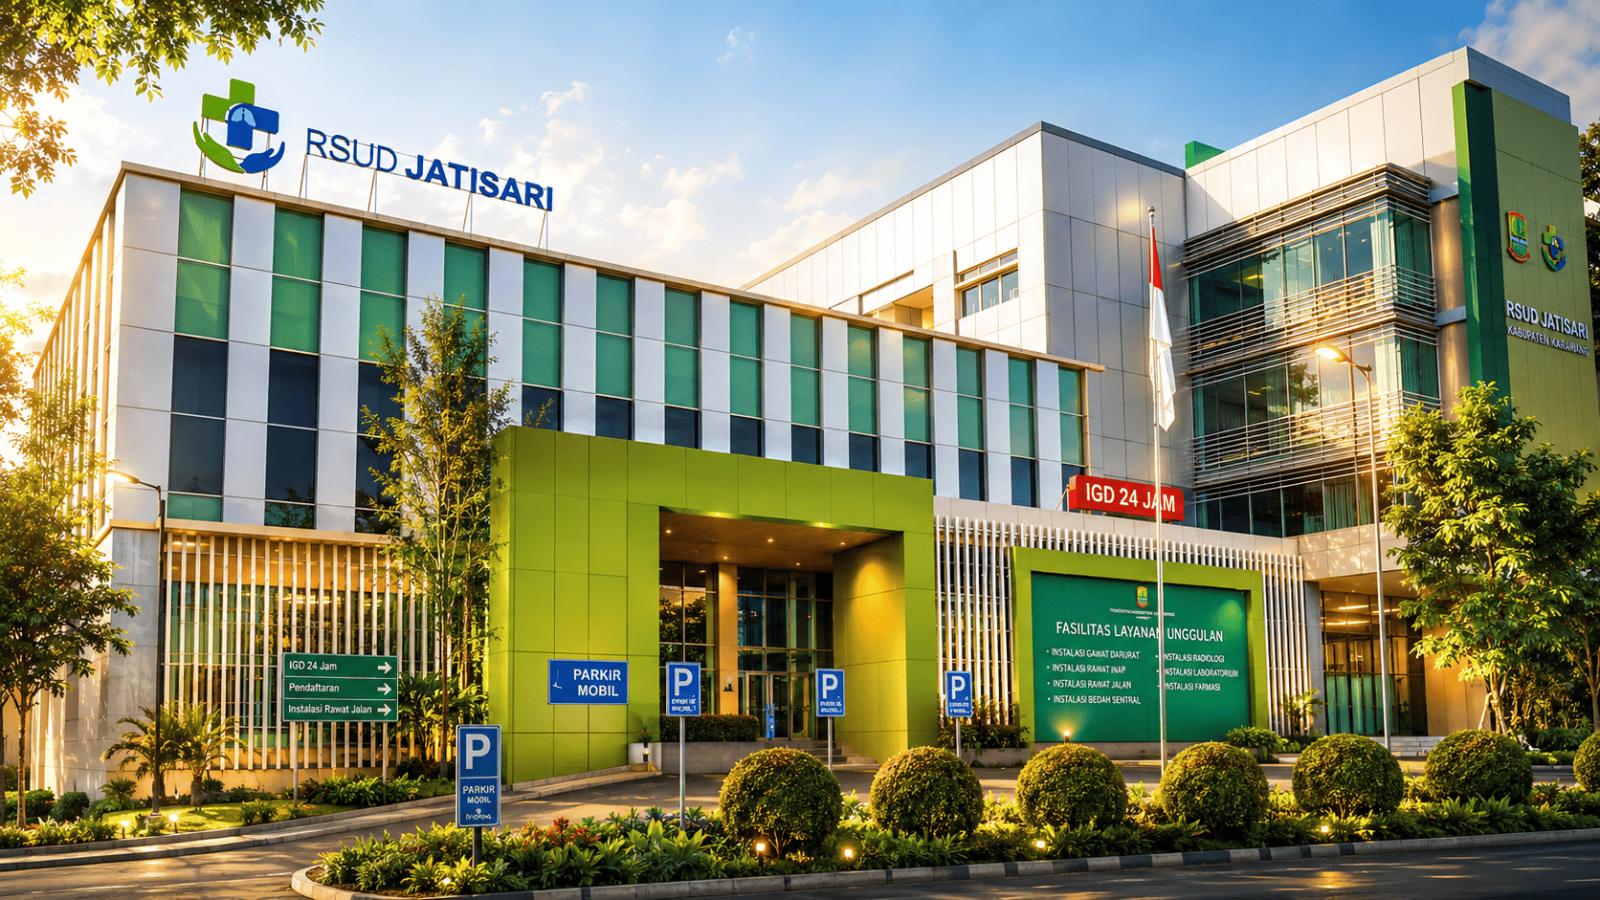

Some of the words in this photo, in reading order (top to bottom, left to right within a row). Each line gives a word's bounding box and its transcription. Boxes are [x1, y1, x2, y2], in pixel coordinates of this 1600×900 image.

[306, 127, 398, 173] RSUD
[405, 154, 553, 212] JATISARI
[1506, 299, 1539, 325] RSUD
[1541, 311, 1589, 340] JATISARI
[1086, 482, 1115, 504] IGD
[1119, 487, 1139, 507] 24
[1056, 621, 1111, 637] FASILITAS
[1167, 627, 1223, 642] UNGGULAN
[1051, 647, 1086, 657] INSTALASI
[1164, 653, 1192, 662] NSTALASI
[289, 660, 305, 670] IGD
[307, 661, 318, 671] 24
[320, 661, 338, 671] Jam
[1052, 663, 1086, 673] INSTALASI
[573, 668, 622, 681] PARKIR
[1165, 667, 1193, 676] NSTALASI
[674, 667, 693, 696] P
[822, 673, 838, 699] P
[1053, 679, 1087, 689] INSTALASI
[1165, 682, 1194, 691] NSTALASI
[289, 682, 340, 693] Pendaftaran
[578, 684, 619, 697] MOBIL
[951, 675, 966, 700] P
[1053, 695, 1087, 704] INSTALASI
[288, 703, 323, 714] Instalasi
[324, 704, 349, 714] Rawat
[465, 733, 491, 770] P
[462, 784, 496, 794] PARKIR
